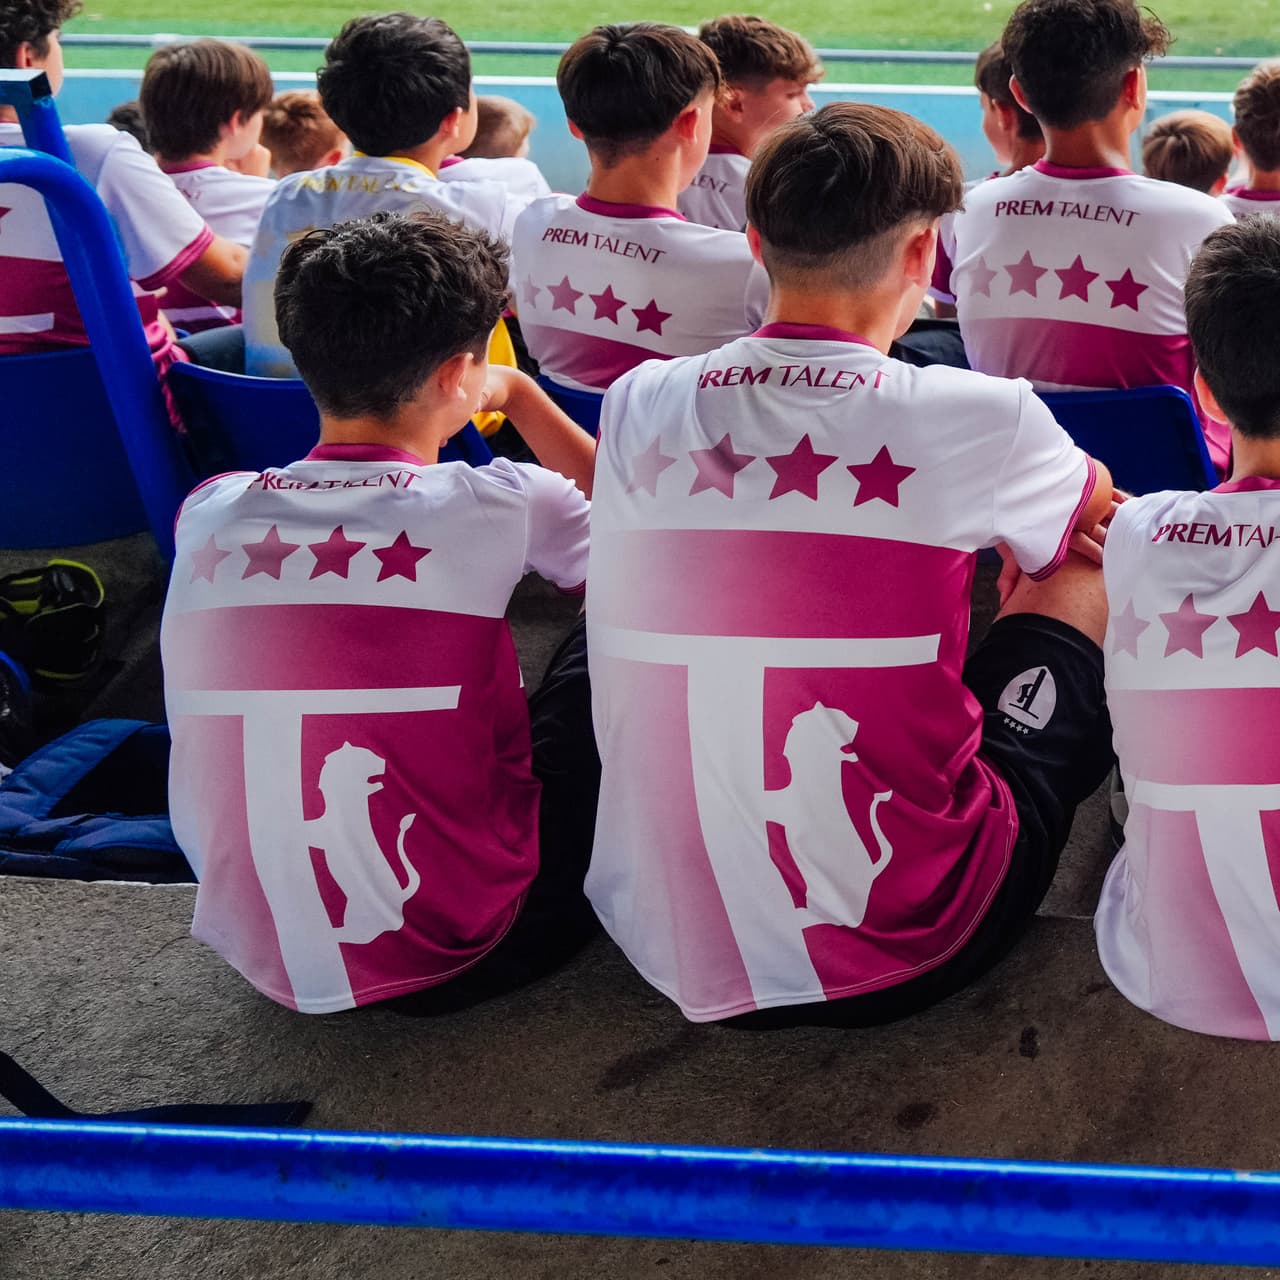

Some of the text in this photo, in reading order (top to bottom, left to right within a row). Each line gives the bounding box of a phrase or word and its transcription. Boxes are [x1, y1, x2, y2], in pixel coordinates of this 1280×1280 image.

[995, 199, 1142, 228] PREM TALENT
[541, 227, 668, 264] PREM TALENT
[1152, 521, 1233, 548] PREM
